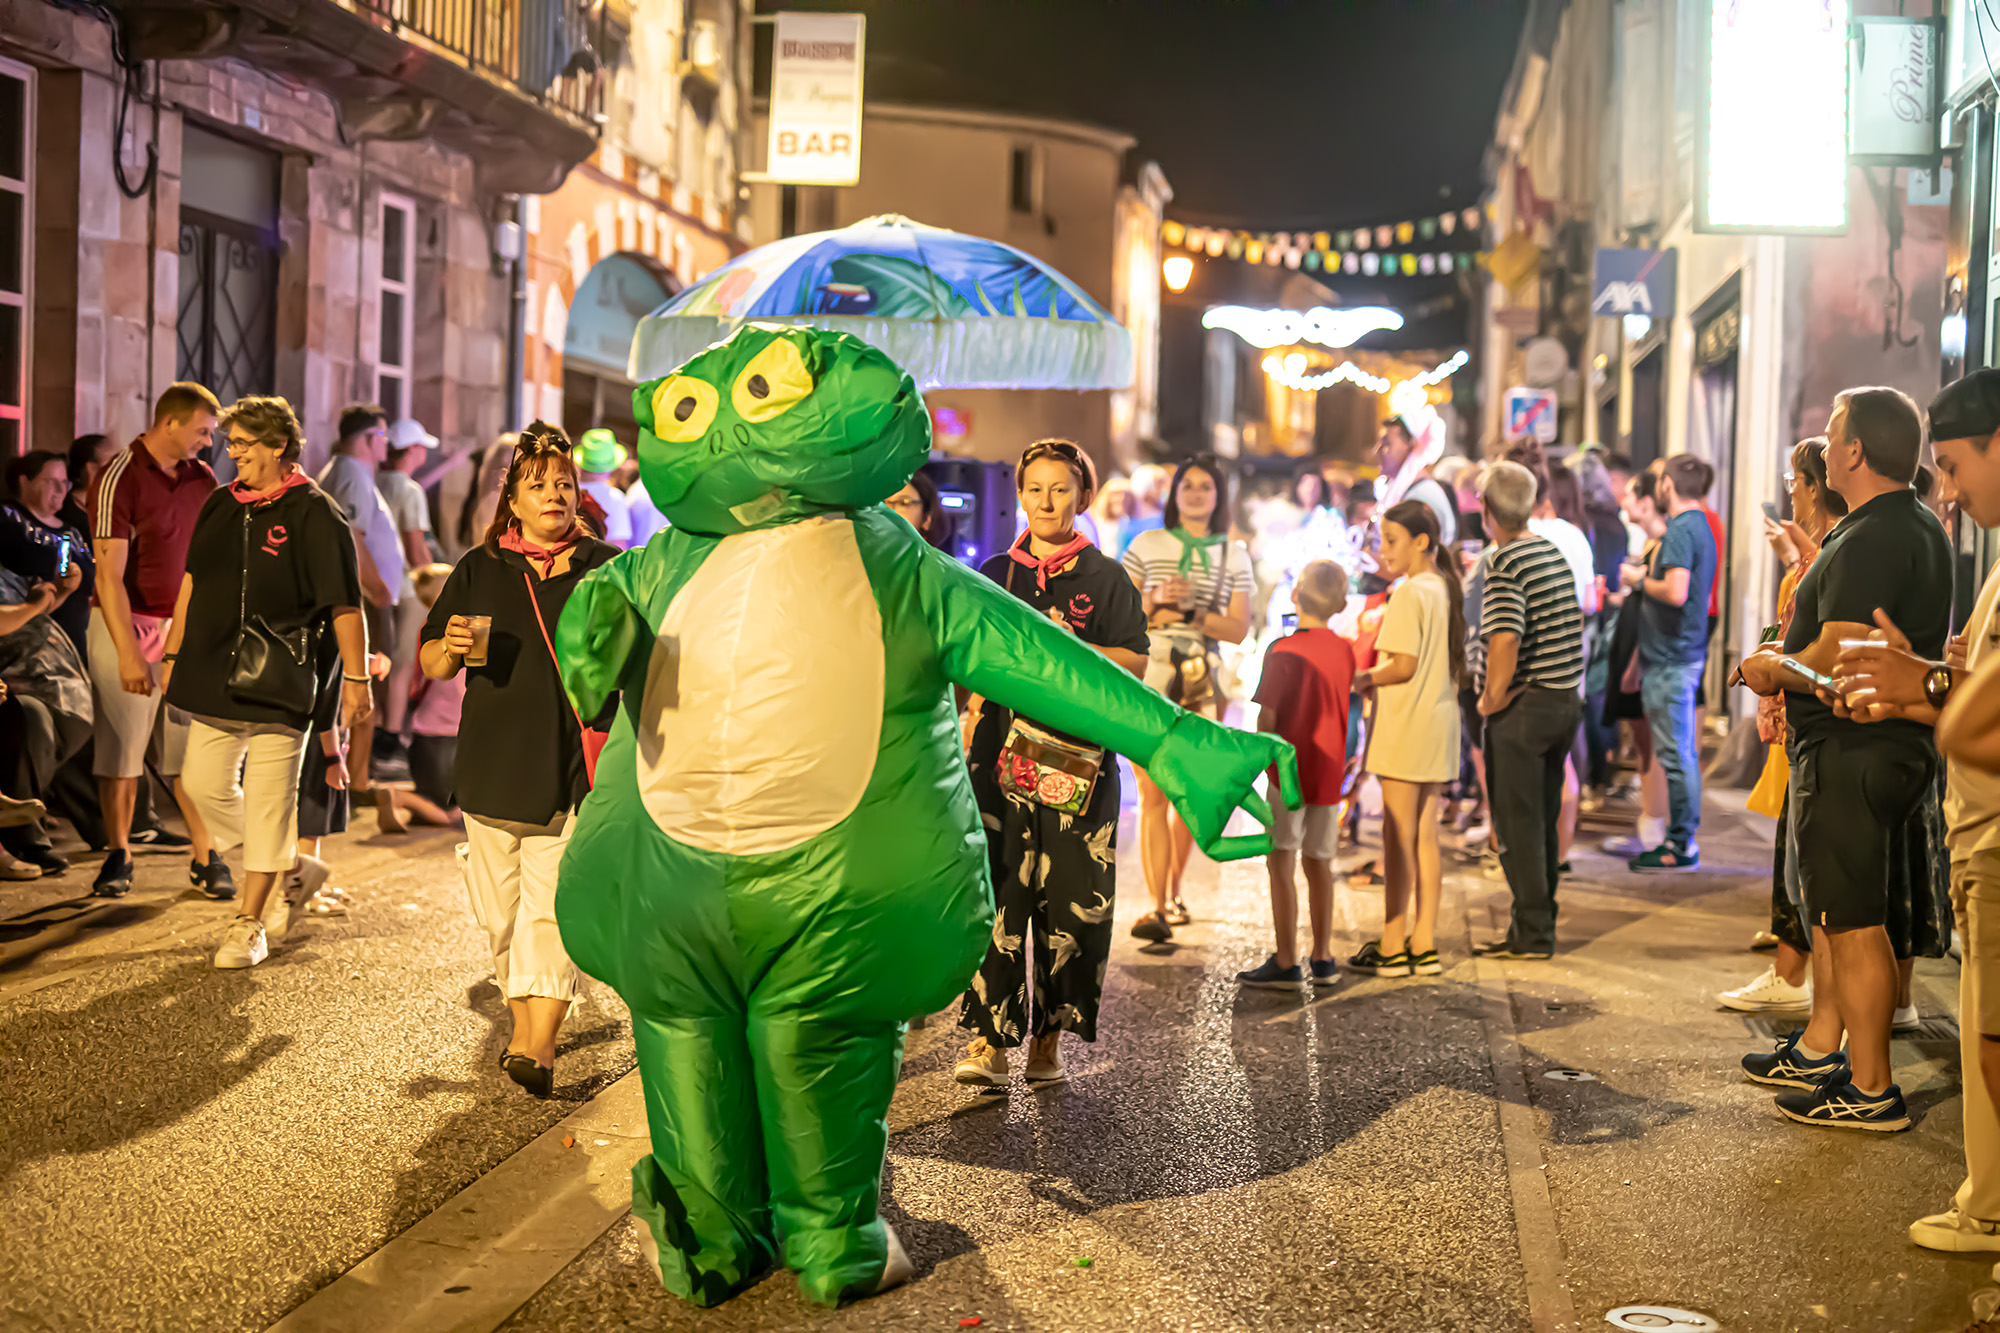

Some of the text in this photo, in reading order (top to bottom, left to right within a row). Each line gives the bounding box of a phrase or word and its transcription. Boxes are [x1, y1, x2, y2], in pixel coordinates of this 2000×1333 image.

[1889, 25, 1923, 124] Prime
[778, 131, 852, 156] BAR
[1591, 281, 1652, 312] AXA
